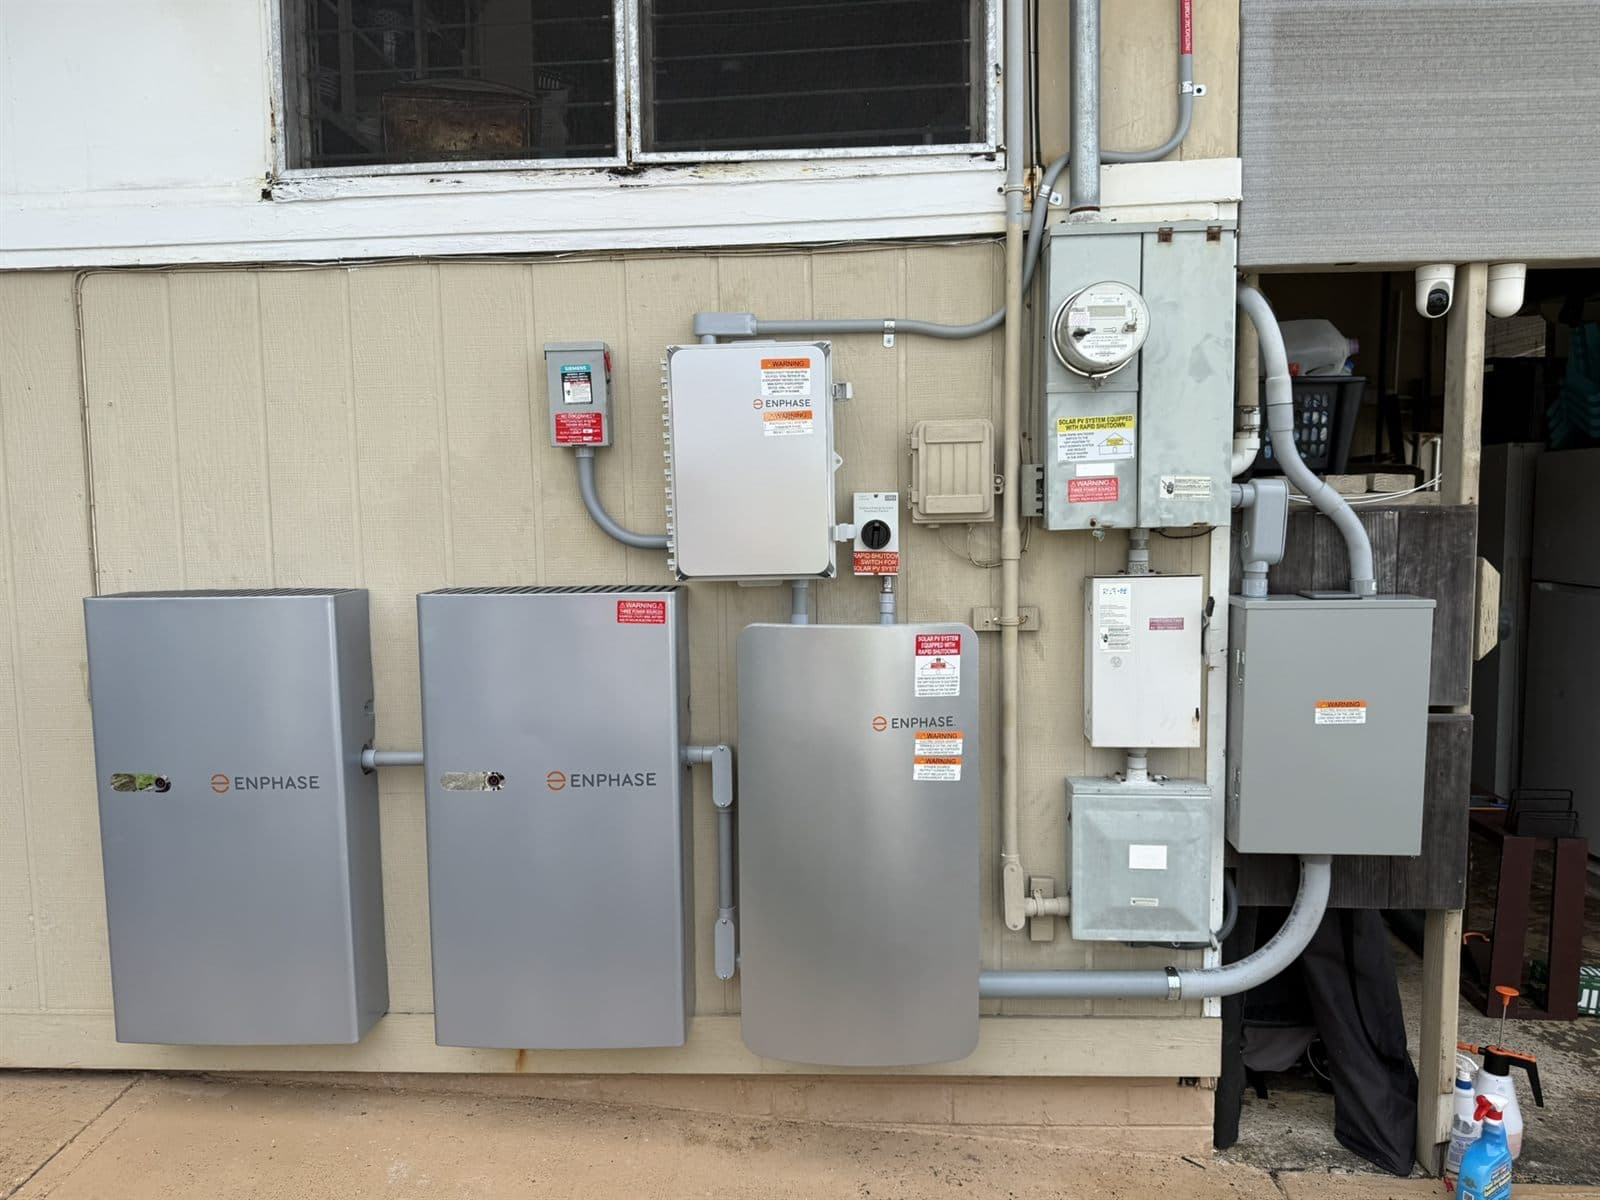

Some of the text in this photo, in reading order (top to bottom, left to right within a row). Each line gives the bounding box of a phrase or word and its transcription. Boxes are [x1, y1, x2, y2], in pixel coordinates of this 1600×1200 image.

[765, 398, 811, 408] ENPHASE
[775, 411, 808, 419] WARNING
[1085, 416, 1106, 424] SYSTEM
[891, 715, 954, 729] ENPHASE
[234, 775, 320, 790] ENPHASE
[570, 772, 657, 787] ENPHASE
